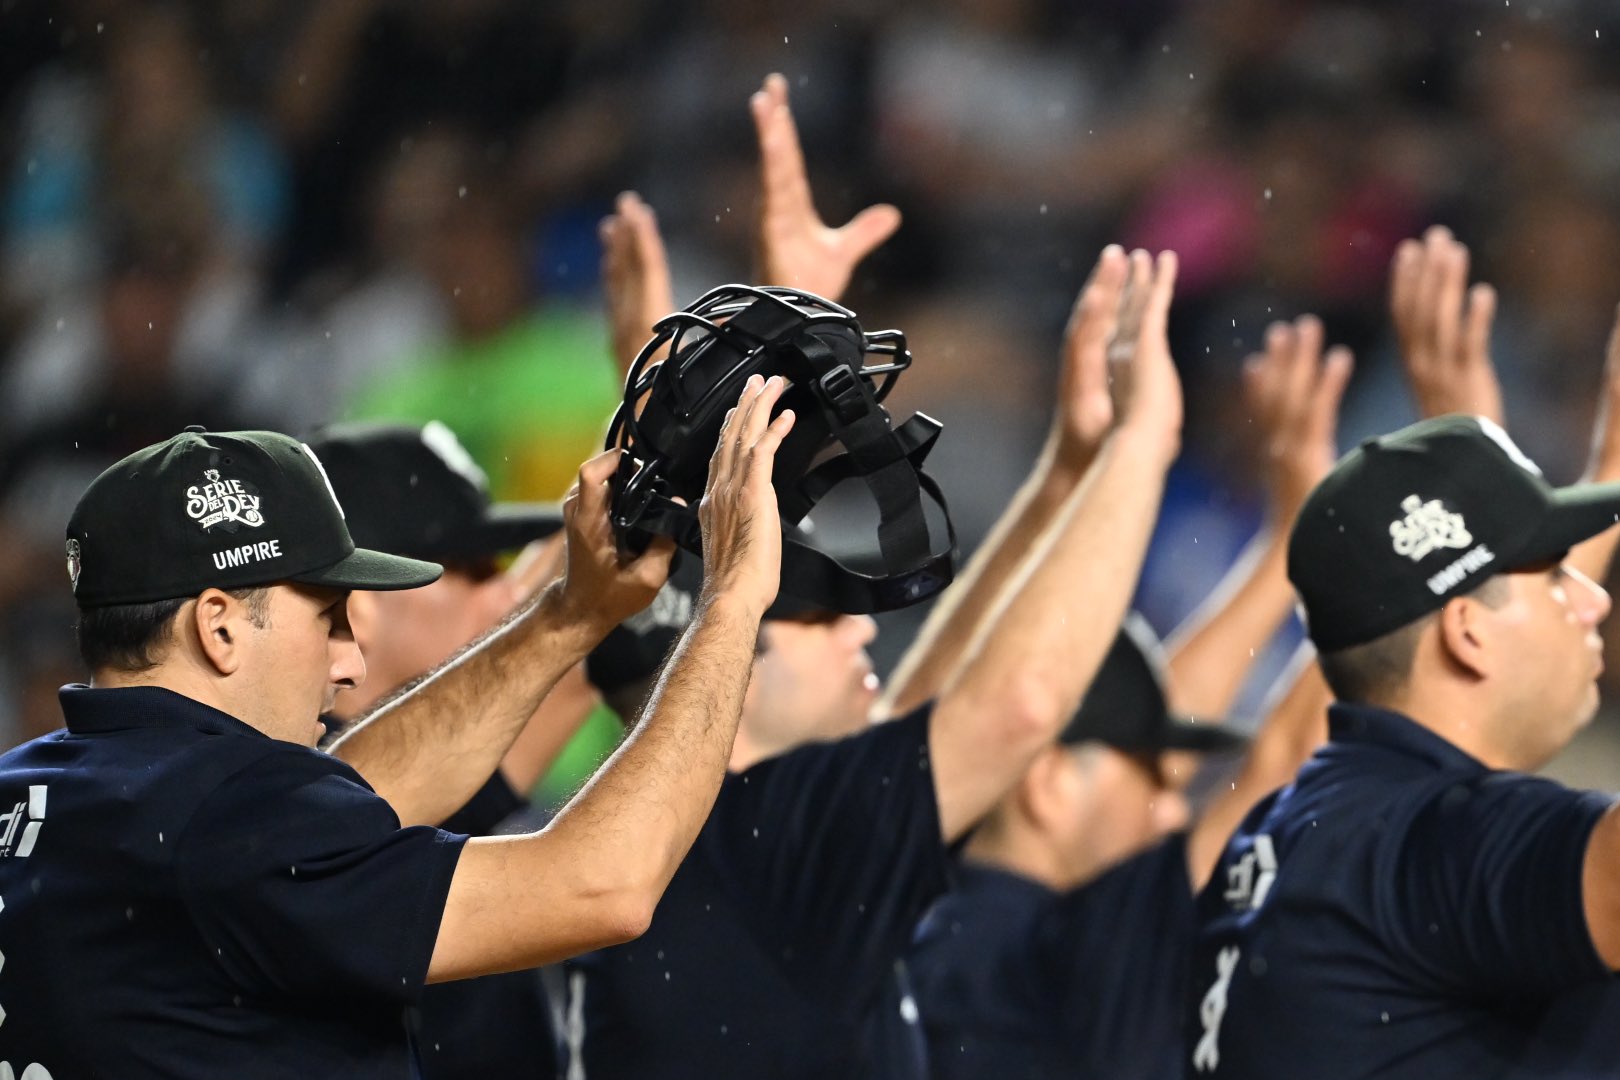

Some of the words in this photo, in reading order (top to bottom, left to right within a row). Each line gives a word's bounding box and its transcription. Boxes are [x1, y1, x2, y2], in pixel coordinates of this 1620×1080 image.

[186, 479, 246, 519] SERIE
[208, 499, 224, 512] DEL
[222, 493, 264, 527] REY
[212, 539, 283, 570] UMPIRE
